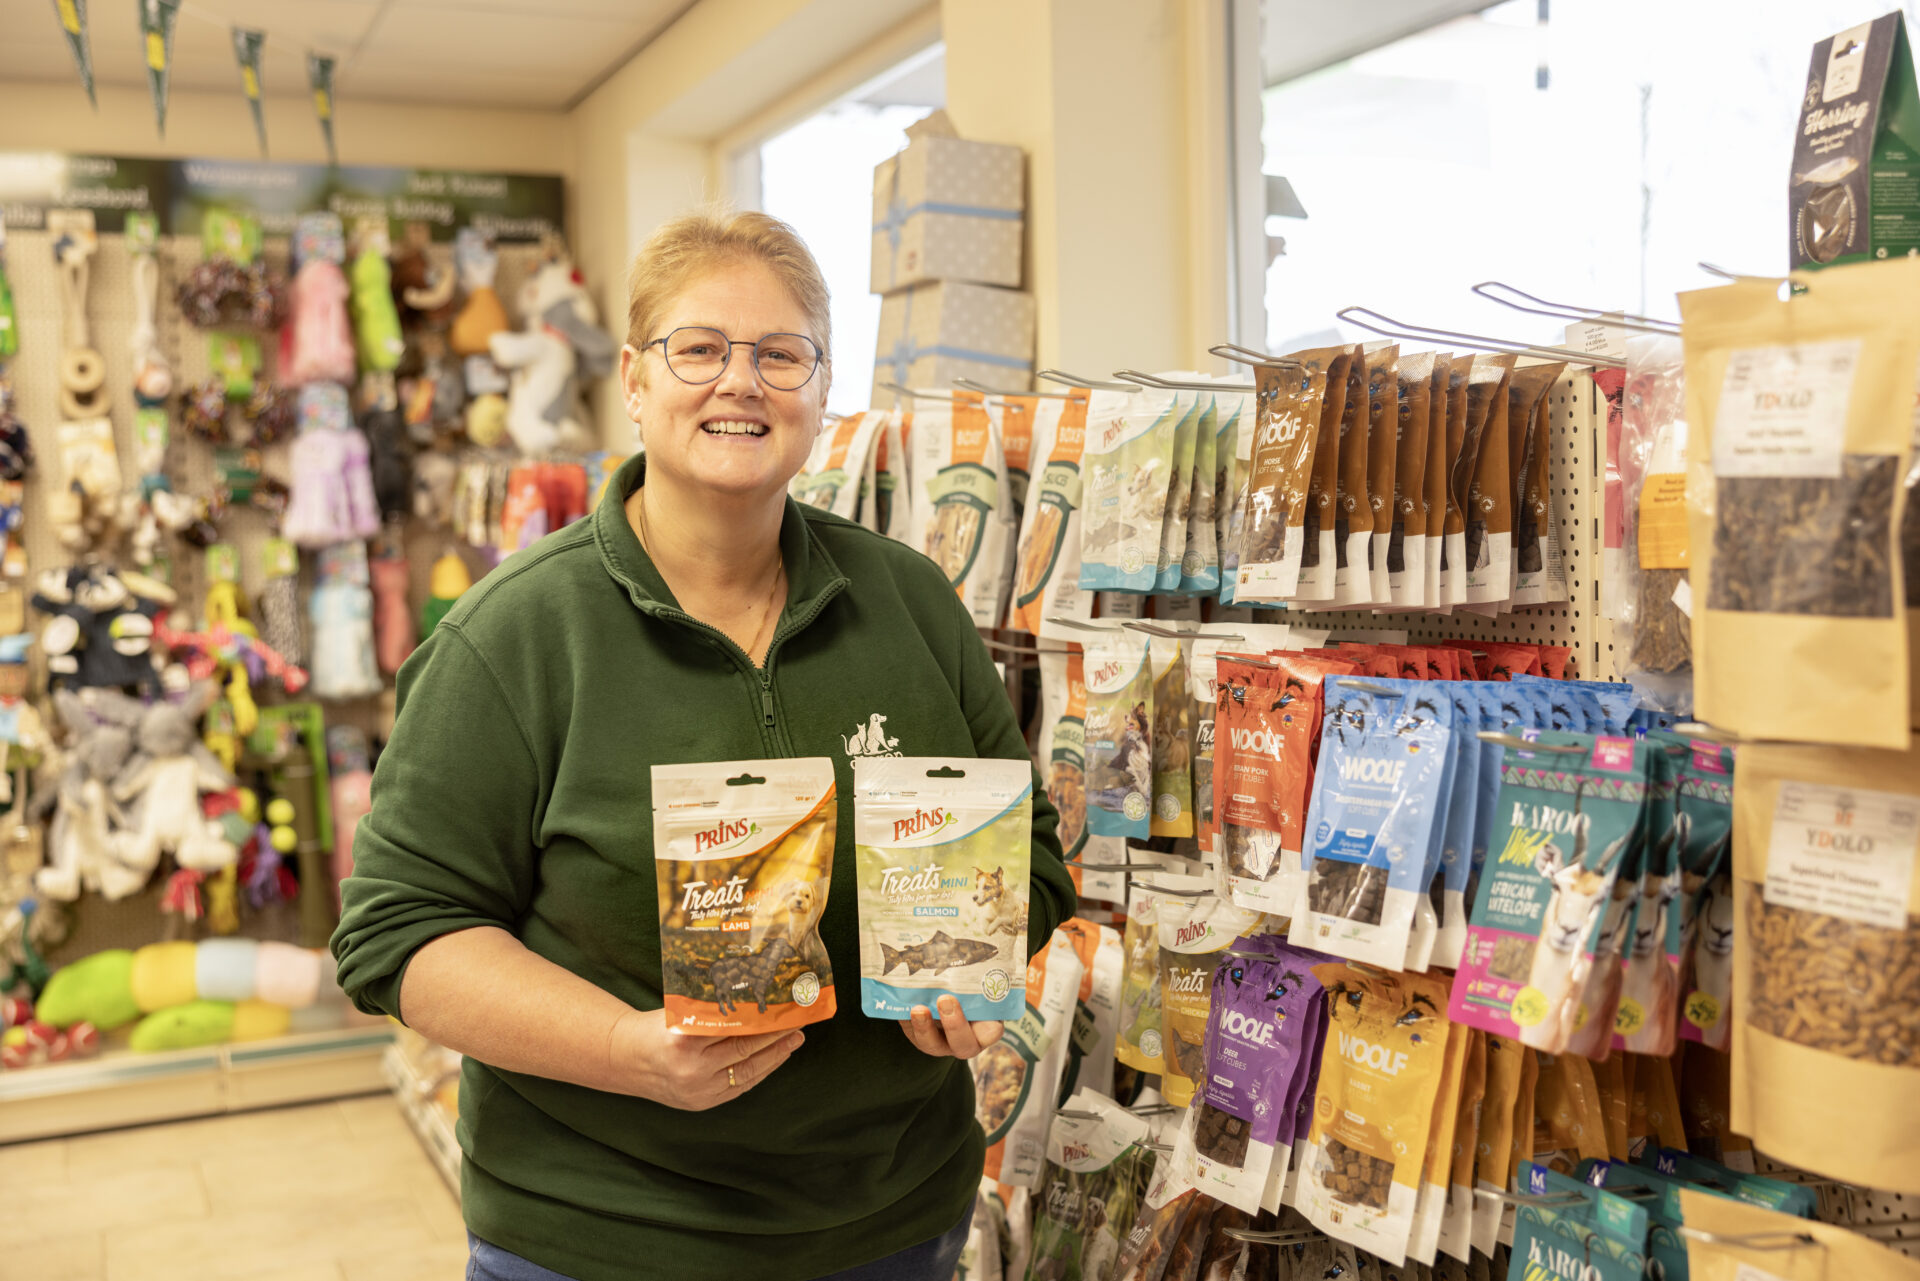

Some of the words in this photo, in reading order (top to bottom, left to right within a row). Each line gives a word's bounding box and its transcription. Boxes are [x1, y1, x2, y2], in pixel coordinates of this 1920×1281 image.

[1804, 101, 1869, 135] Herring
[1093, 661, 1119, 687] PRINS
[1230, 727, 1285, 755] WOOLF
[1251, 766, 1269, 776] PORK
[1345, 756, 1406, 785] WOOLF
[894, 807, 944, 842] PRINS
[1511, 801, 1592, 837] KAROO
[694, 818, 749, 854] PRINS
[1806, 828, 1874, 855] YDOLO
[880, 863, 945, 896] Treats
[940, 877, 968, 889] MINI
[681, 875, 749, 912] Treats
[745, 887, 774, 902] MINI
[720, 906, 730, 918] for
[731, 906, 745, 916] your
[745, 901, 760, 913] dog!
[915, 907, 957, 916] SALMON
[722, 921, 750, 931] LAMB
[1174, 920, 1207, 947] PRINS
[1168, 967, 1208, 993] Treats
[1222, 1008, 1274, 1045] WOOLF
[1223, 1047, 1239, 1059] DEER
[1227, 1056, 1247, 1071] CUBES
[1339, 1031, 1408, 1076] WOOLF
[1063, 1140, 1090, 1163] PRINS
[1527, 1236, 1603, 1281] KAROO
